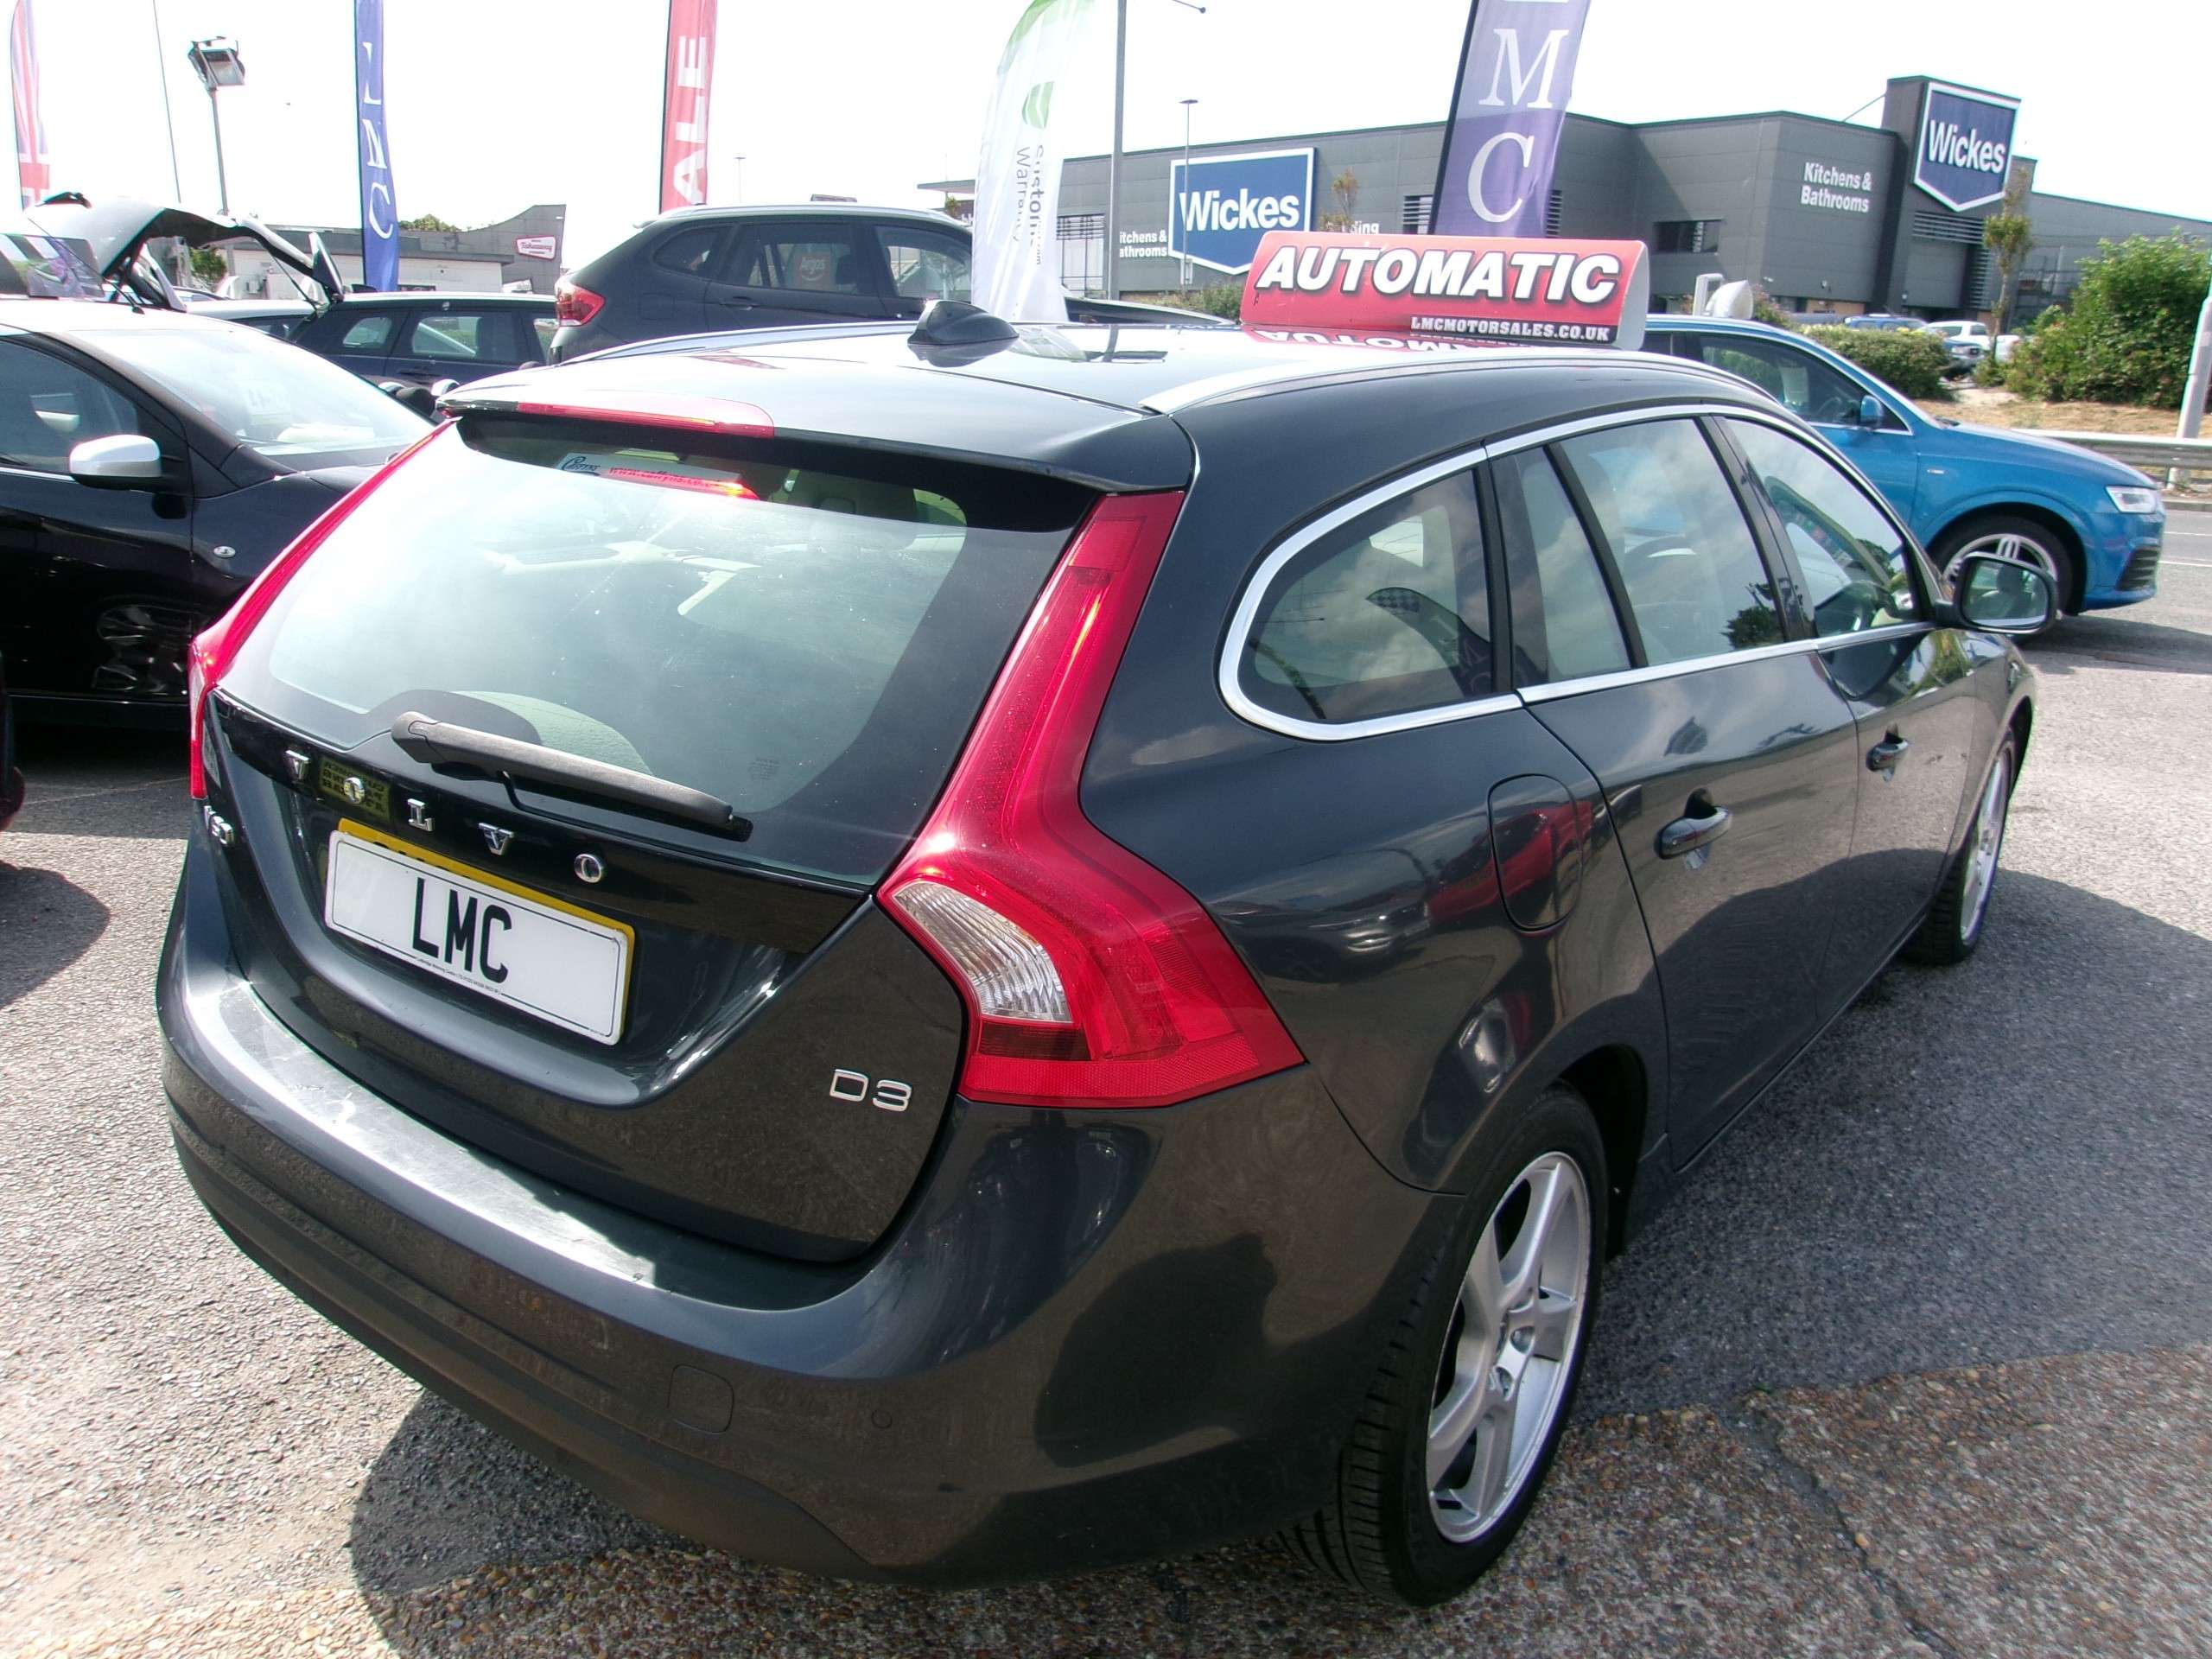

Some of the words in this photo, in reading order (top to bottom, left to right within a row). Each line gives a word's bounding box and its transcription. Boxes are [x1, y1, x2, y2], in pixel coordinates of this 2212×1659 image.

[673, 35, 707, 205] ALE
[1467, 0, 1570, 223] MC
[1929, 119, 2005, 175] Wickes
[1804, 162, 1860, 189] Kitchens
[1861, 172, 1872, 191] &
[1179, 188, 1300, 232] Wickes
[1801, 186, 1870, 213] Bathrooms
[1119, 231, 1158, 244] itchens
[1159, 229, 1167, 243] &
[1119, 245, 1167, 257] athrooms
[1255, 245, 1621, 305] AUTOMATIC
[1410, 316, 1611, 341] LMCMOTORSALES.CO.UK
[285, 749, 605, 883] VOLVO
[411, 877, 512, 983] LMC
[830, 1068, 912, 1112] D3
